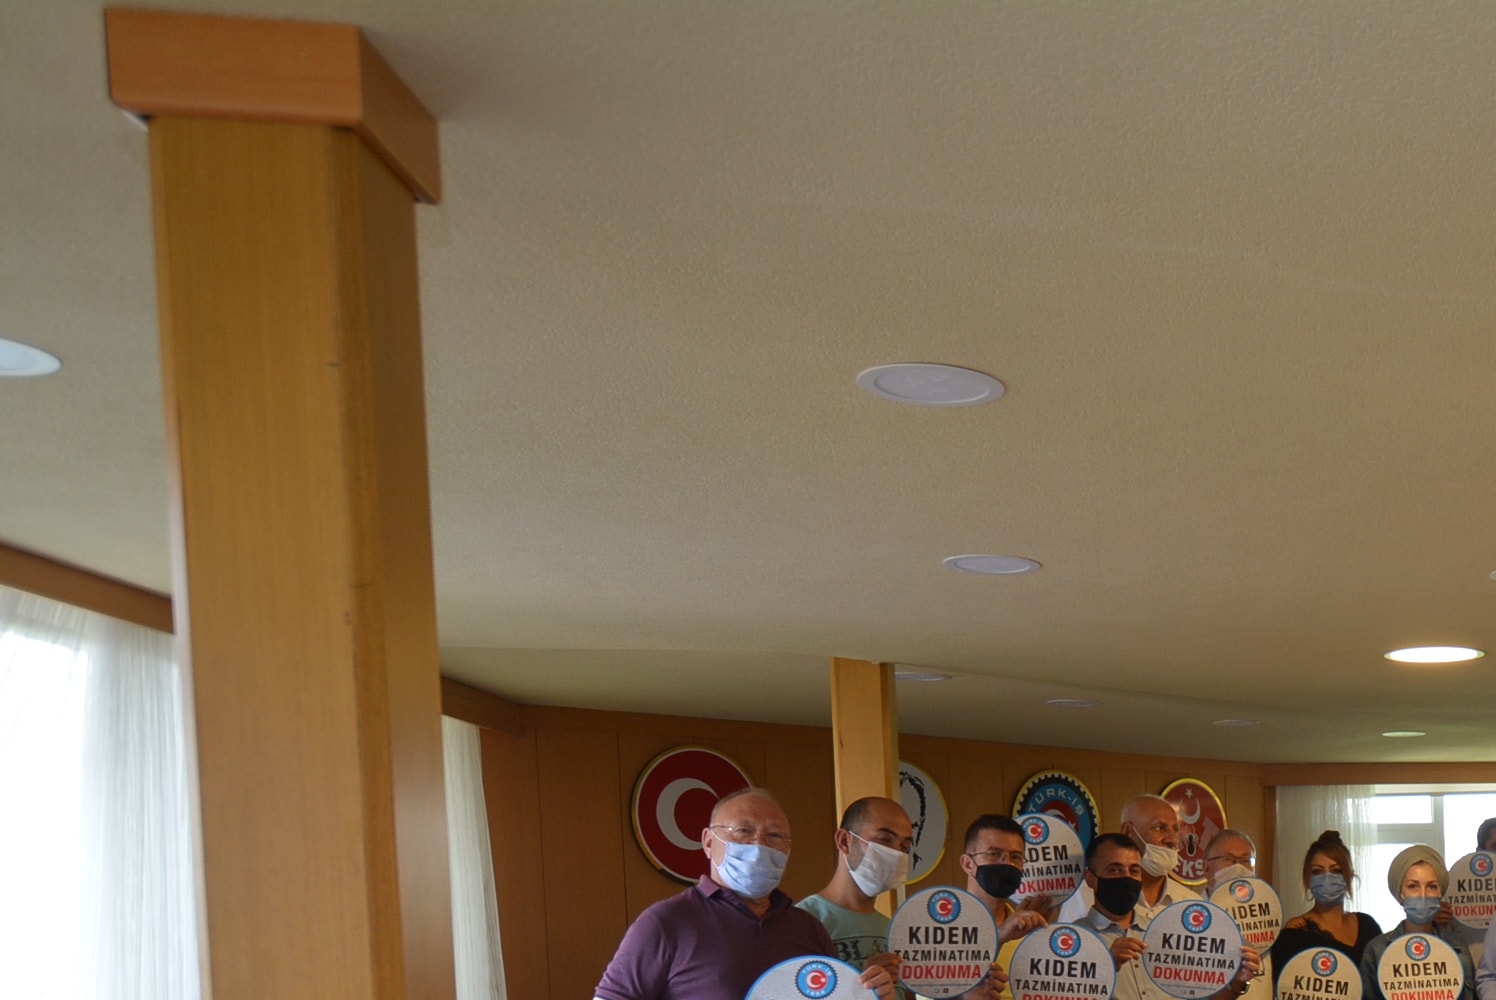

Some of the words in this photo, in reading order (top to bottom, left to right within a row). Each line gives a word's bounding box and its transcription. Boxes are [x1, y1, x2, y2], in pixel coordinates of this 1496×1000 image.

[1028, 788, 1085, 817] TÜRK-İŞ
[1024, 845, 1069, 863] DEM
[1022, 863, 1081, 878] MİNATIMA
[1018, 876, 1076, 894] OKUNMA
[1231, 902, 1270, 920] IDEM
[1240, 918, 1280, 932] İNATIMA
[908, 926, 978, 945] KIDEM
[1162, 932, 1226, 954] KIDEM
[1245, 930, 1275, 944] UNMA
[1030, 958, 1097, 979] KIDEM
[1147, 952, 1235, 970] TAZMİNATIMA
[1392, 962, 1447, 978] KIDEM
[902, 964, 982, 980] DOKUNMA
[1153, 966, 1226, 984] DOKUNMA
[1015, 979, 1108, 996] TAZMİNATIMA
[1293, 975, 1349, 996] KIDEM
[1384, 978, 1460, 991] TAZMİNATIMA
